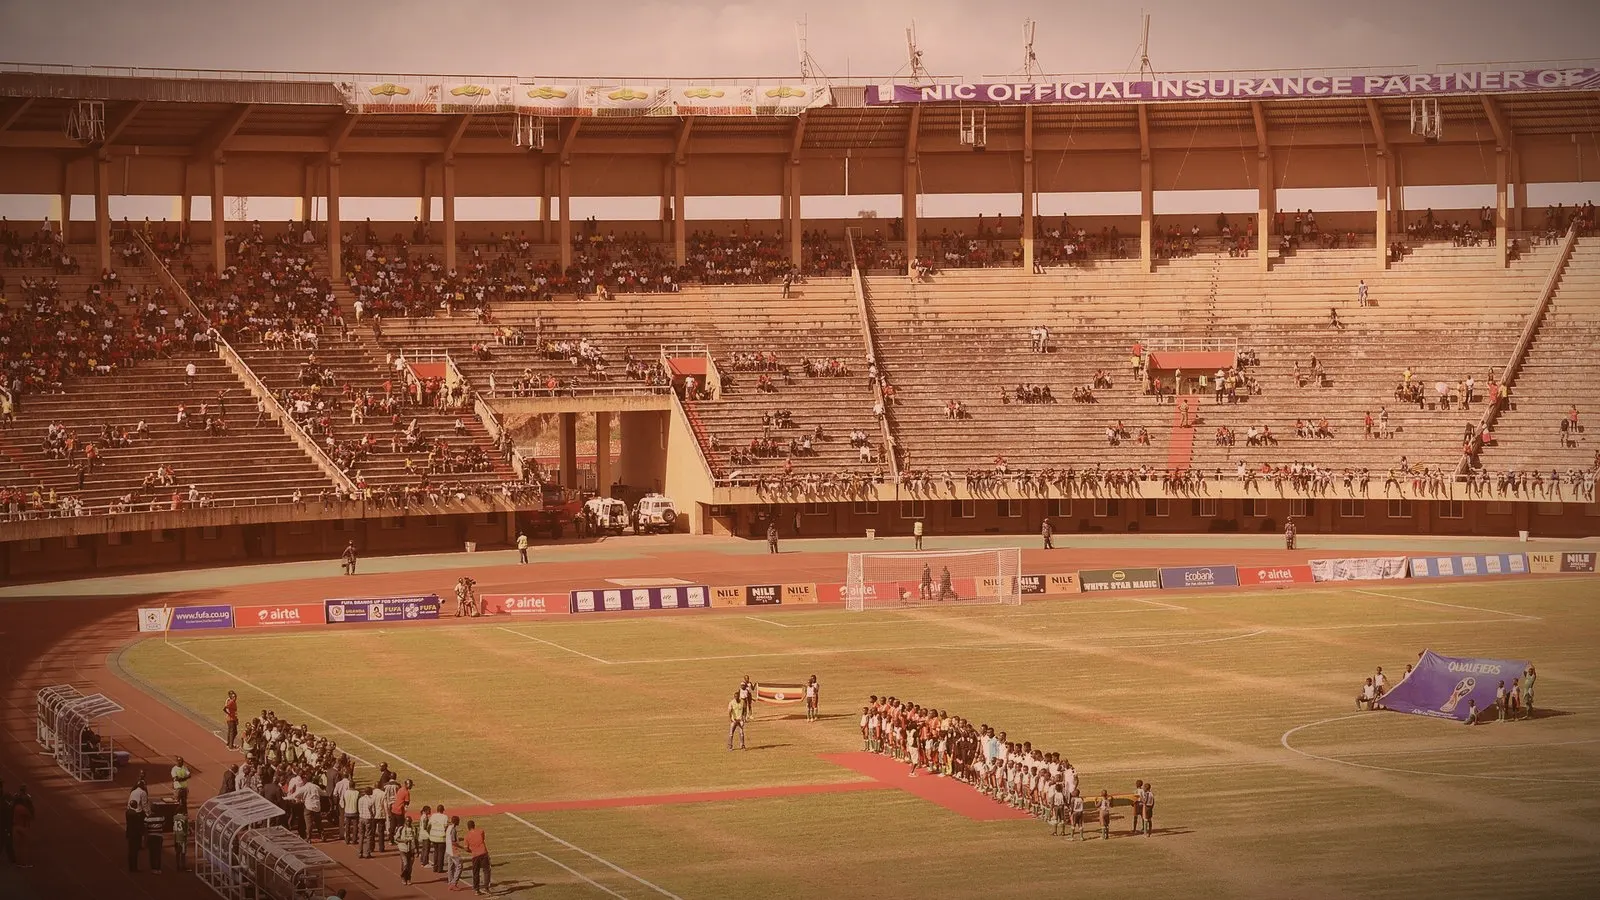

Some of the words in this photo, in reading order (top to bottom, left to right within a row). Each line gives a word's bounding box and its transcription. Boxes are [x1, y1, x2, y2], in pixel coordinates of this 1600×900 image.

[921, 84, 976, 100] NIC
[987, 81, 1142, 99] OFFICIAL
[1152, 76, 1352, 98] INSURANCE
[1364, 70, 1526, 93] PARTNER
[1537, 69, 1583, 87] OF
[1567, 553, 1590, 563] NILE
[1184, 570, 1214, 581] Ecobank
[1267, 568, 1293, 579] airtel
[1051, 576, 1073, 584] NILE
[1083, 582, 1109, 591] WHITE
[1110, 581, 1132, 590] STAR
[1133, 580, 1157, 589] MAGIC
[717, 589, 739, 598] NILE
[751, 587, 776, 597] NILE
[787, 586, 810, 595] NILE
[516, 596, 546, 608] airtel
[176, 611, 230, 620] www.fufa.co.ug
[270, 608, 300, 620] airtel
[1448, 661, 1502, 675] QUALIFIERS
